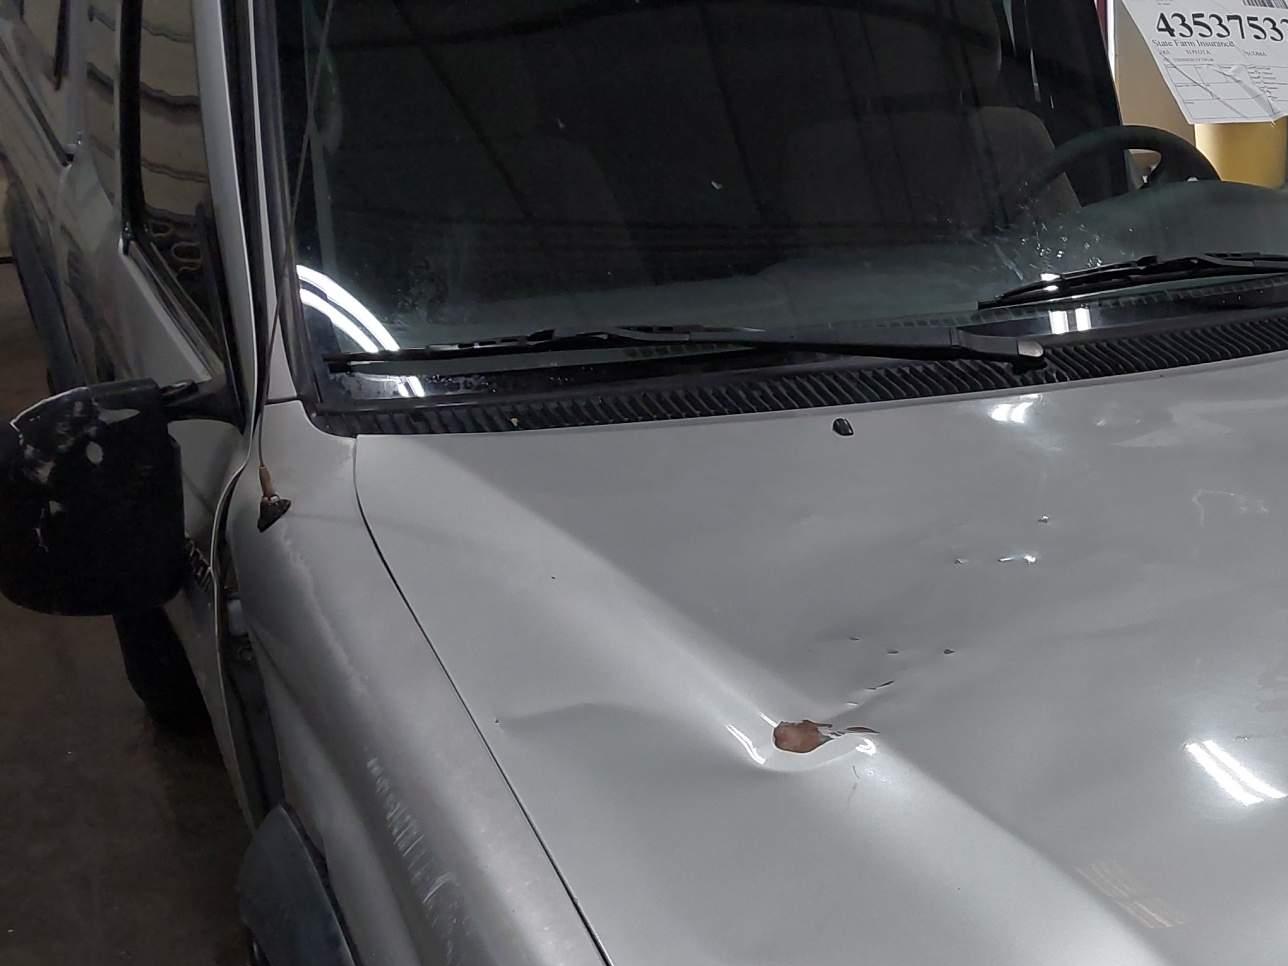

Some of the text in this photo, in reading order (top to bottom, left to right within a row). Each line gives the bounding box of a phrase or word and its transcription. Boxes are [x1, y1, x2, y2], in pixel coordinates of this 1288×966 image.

[1152, 39, 1235, 48] State Farm Insurance
